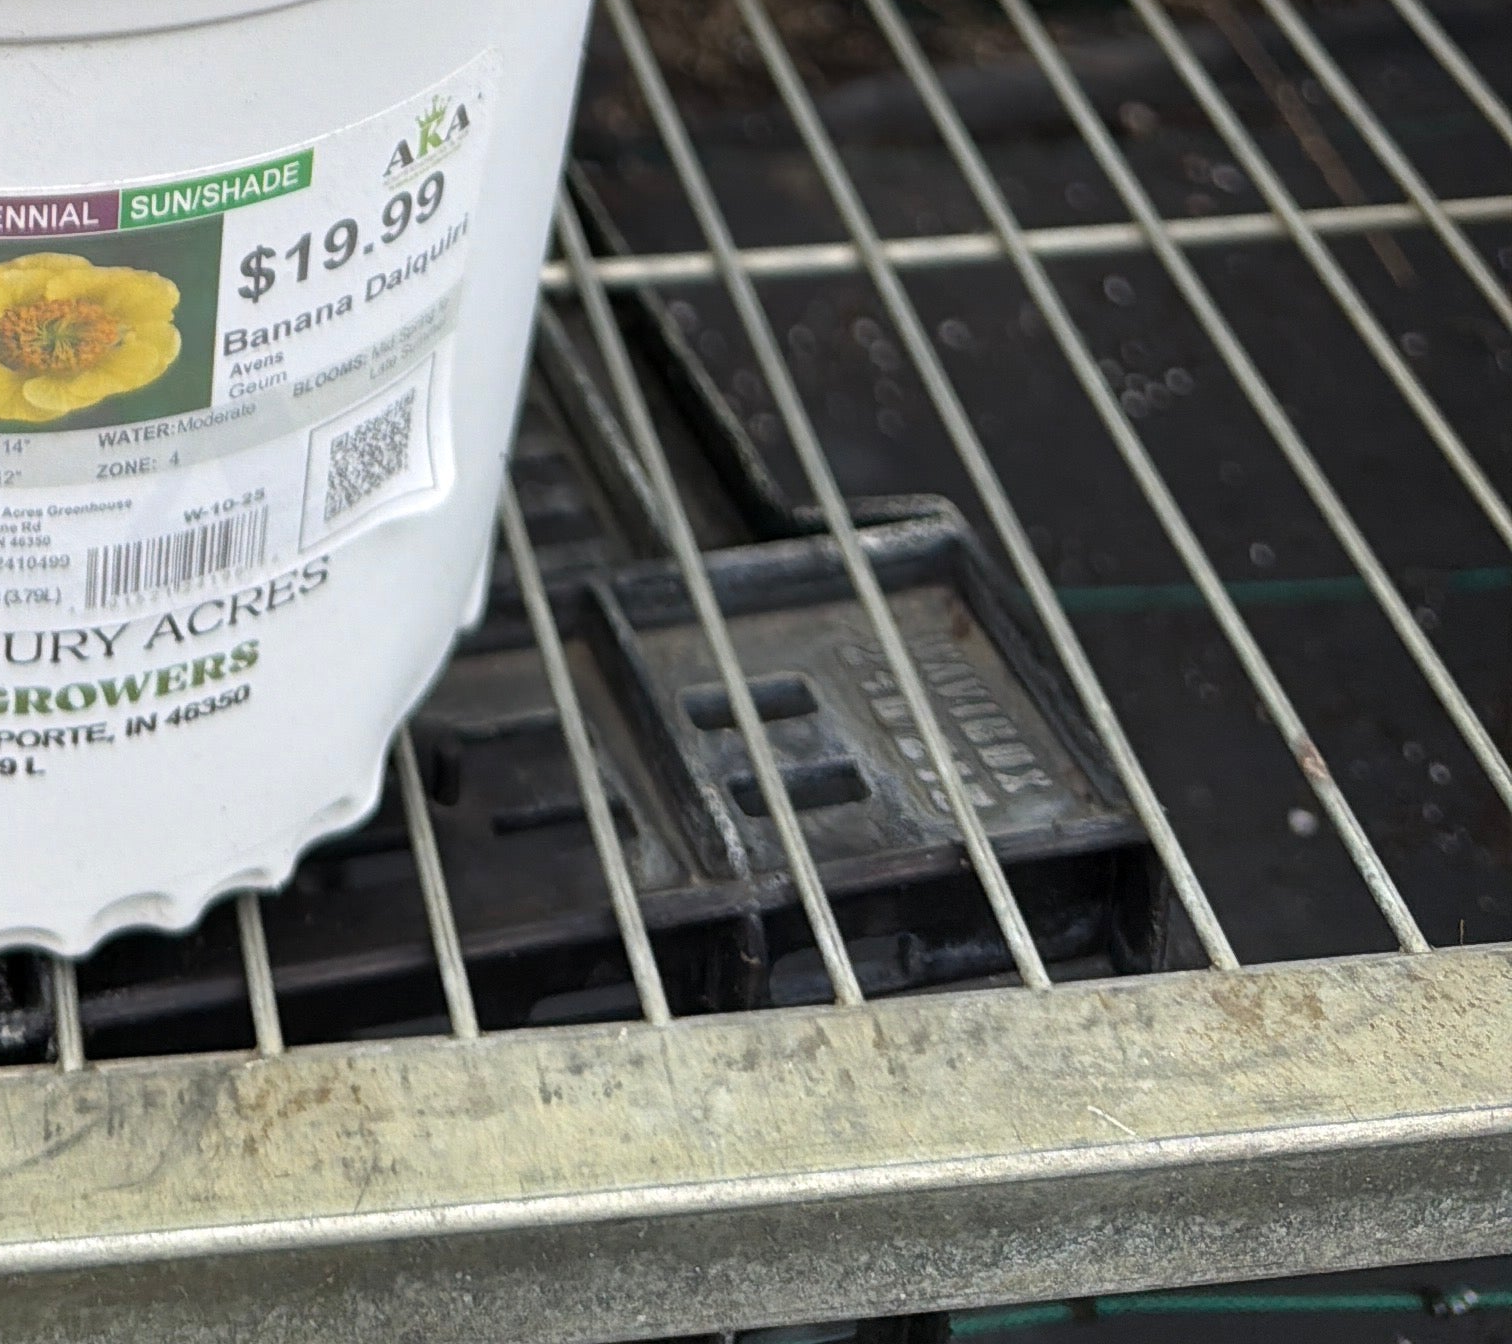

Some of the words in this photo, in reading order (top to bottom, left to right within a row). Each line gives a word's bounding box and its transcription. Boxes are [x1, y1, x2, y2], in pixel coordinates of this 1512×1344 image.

[383, 102, 470, 178] AKA
[130, 160, 300, 220] SUN/SHADE
[238, 170, 445, 303] $19.99
[223, 294, 353, 356] Banana
[365, 212, 468, 303] Daiquiri
[229, 349, 284, 378] Avens
[229, 371, 287, 399] Geum
[98, 422, 175, 450] WATER:
[177, 401, 257, 434] Moderate
[2, 438, 31, 454] 14"
[96, 456, 157, 479] ZONE:
[168, 450, 180, 467] 4
[1, 506, 44, 518] Acres
[46, 498, 133, 517] Greenhouse
[183, 487, 266, 523] W-10-25
[9, 534, 51, 547] 46350
[21, 519, 41, 533] Rd
[144, 555, 330, 650] ACRES
[125, 712, 158, 738] IN
[164, 684, 252, 725] 46350
[25, 757, 45, 776] L
